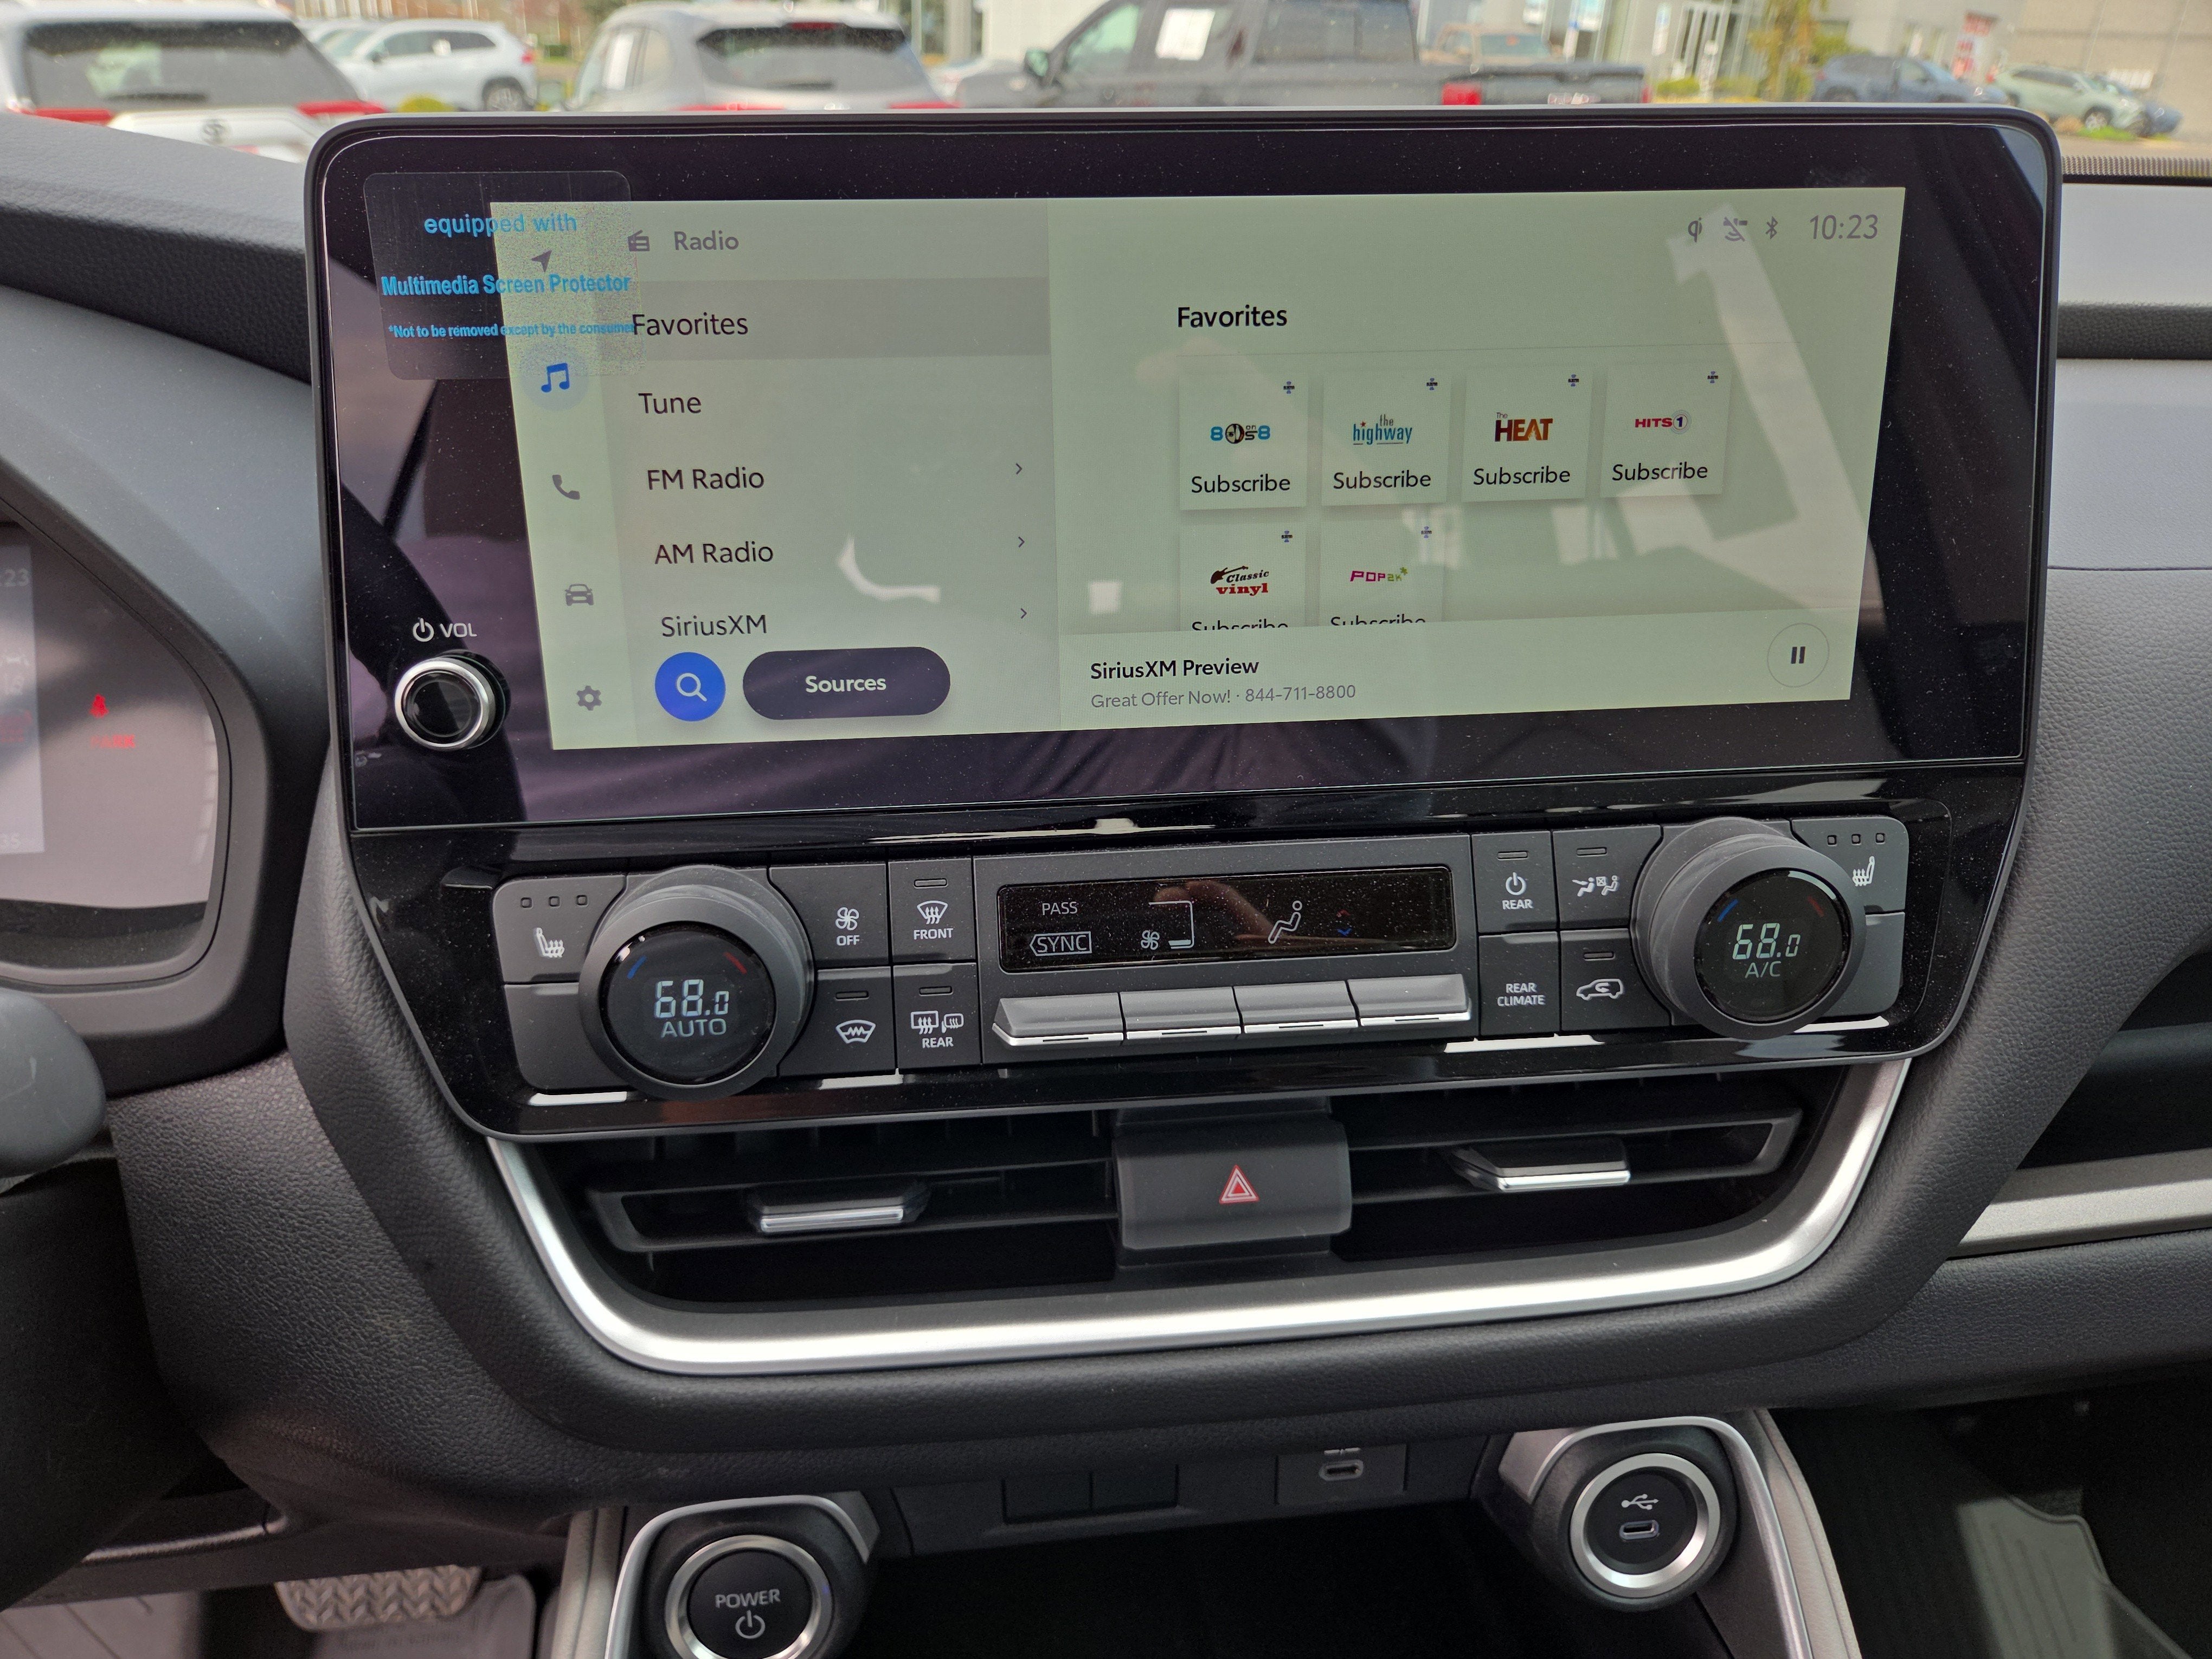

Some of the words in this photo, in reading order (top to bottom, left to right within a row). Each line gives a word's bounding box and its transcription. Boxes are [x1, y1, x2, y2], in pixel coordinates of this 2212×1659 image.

[424, 214, 524, 237] equipped
[533, 213, 577, 232] with
[1809, 214, 1879, 240] 10:23
[673, 230, 739, 251] Radio
[381, 274, 479, 296] Multimedia
[483, 274, 545, 294] Screen
[549, 273, 630, 293] Protector
[632, 312, 749, 336] Favorites
[1177, 304, 1288, 327] Favorites
[416, 325, 429, 337] to
[431, 324, 447, 337] be
[448, 323, 499, 337] removed
[500, 324, 539, 337] except
[541, 323, 555, 337] by
[558, 323, 576, 334] the
[638, 392, 702, 415] Tune
[1379, 414, 1394, 426] the
[1494, 418, 1553, 442] HEAT
[1353, 422, 1413, 445] highway
[647, 468, 684, 491] FM
[692, 467, 764, 490] Radio
[1333, 470, 1432, 490] Subscribe
[1473, 466, 1571, 486] Subscribe
[1612, 461, 1708, 481] Subscribe
[1191, 473, 1291, 493] Subscribe
[654, 544, 695, 565] AM
[702, 541, 774, 563] Radio
[1226, 569, 1270, 583] Classic
[1216, 582, 1269, 596] vinyl
[439, 622, 478, 638] VOL
[660, 614, 768, 638] SiriusXM
[1091, 660, 1176, 679] SiriusXM
[1183, 658, 1259, 676] Preview
[805, 674, 887, 693] Sources
[1091, 693, 1136, 708] Great
[1141, 691, 1185, 706] Offer
[1188, 689, 1231, 704] Now!
[1245, 684, 1356, 703] 844-711-8800
[1041, 901, 1078, 915] PASS
[1502, 898, 1533, 910] REAR
[836, 935, 860, 946] OFF
[913, 928, 954, 940] FRONT
[1037, 934, 1088, 954] SYNC
[1732, 922, 1801, 960] 68.0
[1744, 961, 1782, 979] A/C
[1506, 982, 1537, 993] REAR
[654, 979, 730, 1019] 68.0
[1497, 994, 1546, 1007] CLIMATE
[661, 1018, 727, 1038] AUTO
[922, 1037, 954, 1049] REAR
[715, 1589, 781, 1609] POWER
